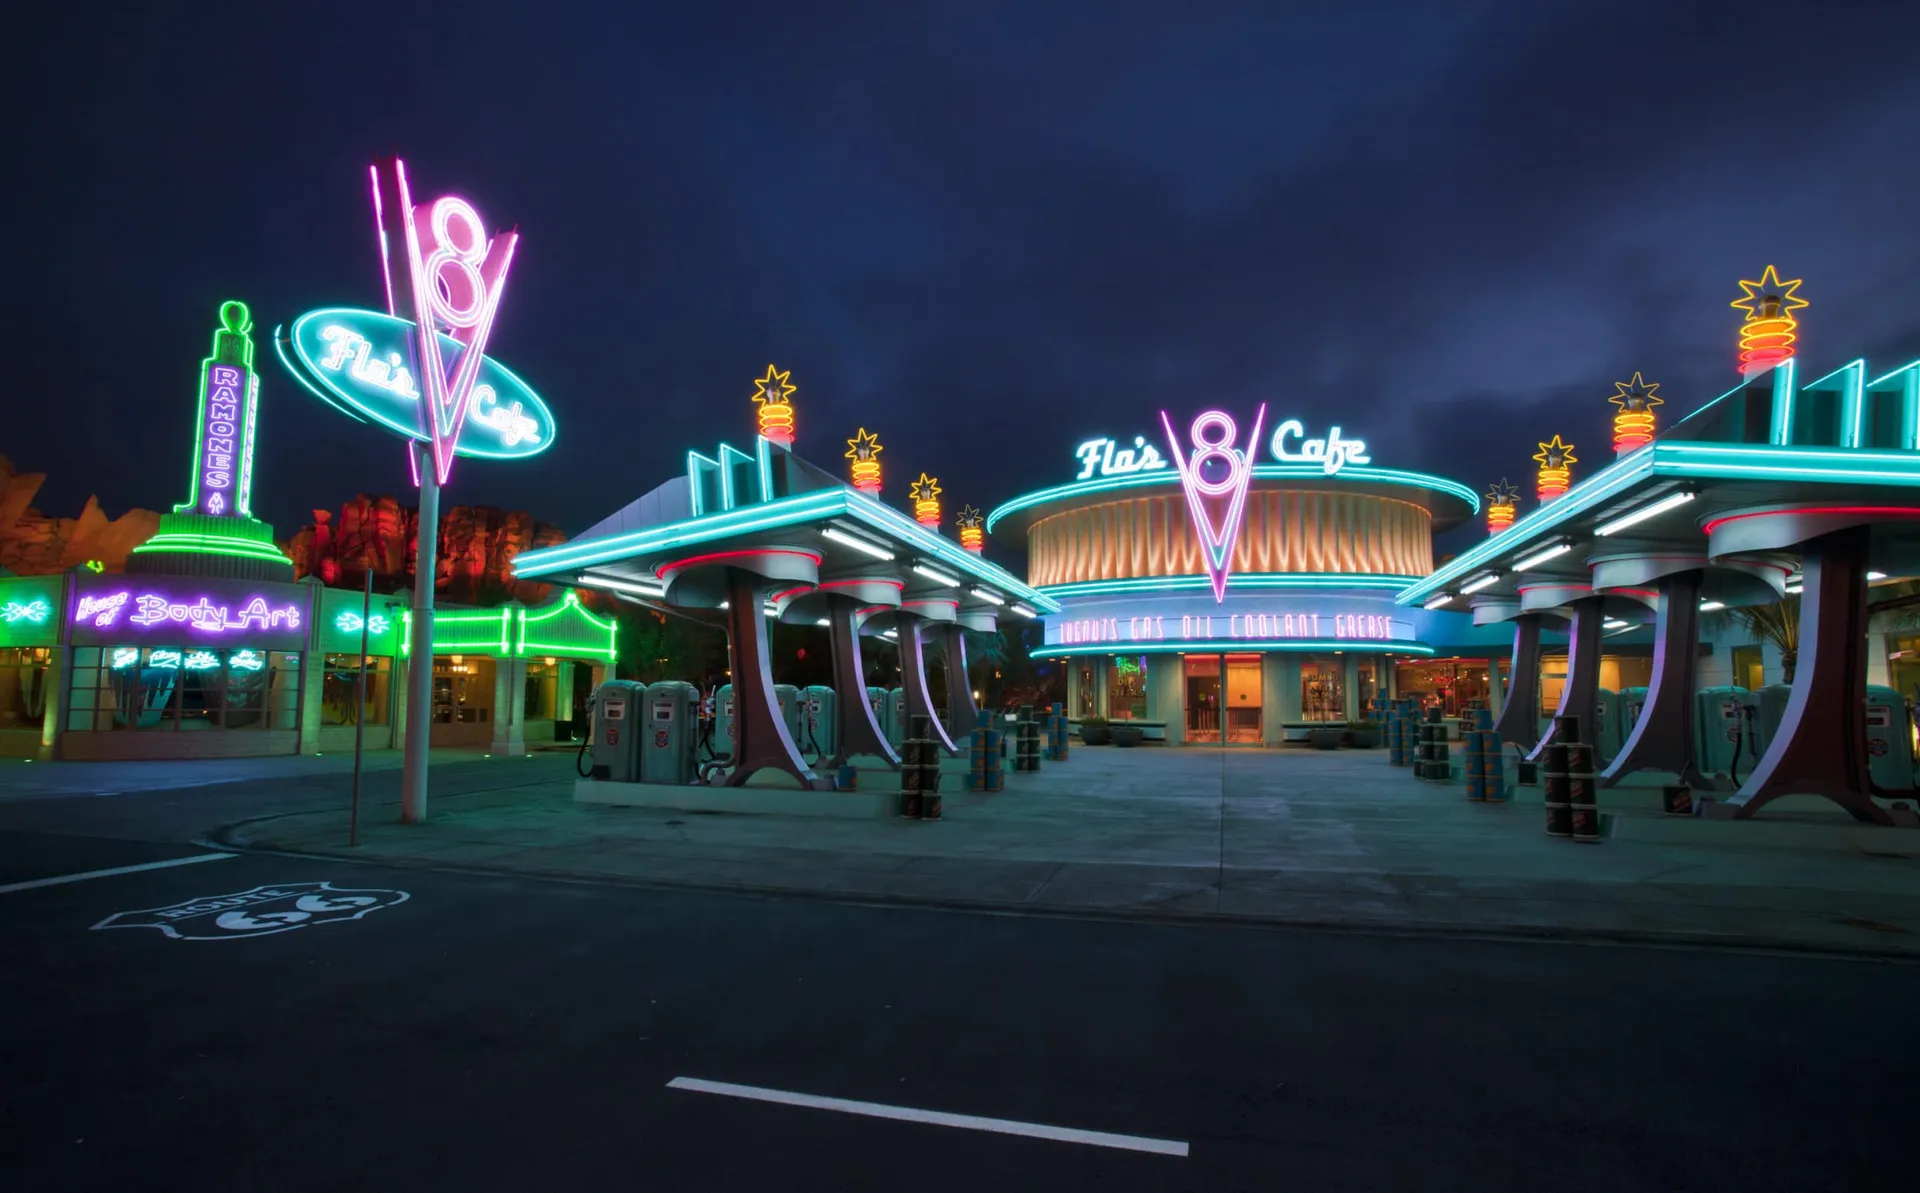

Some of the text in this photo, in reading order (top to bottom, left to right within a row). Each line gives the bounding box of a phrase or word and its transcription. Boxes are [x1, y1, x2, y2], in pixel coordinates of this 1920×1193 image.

[206, 367, 239, 488] RAMONES
[469, 384, 542, 446] Cafe
[1075, 436, 1168, 480] Flo's
[1271, 419, 1372, 475] Cafe
[75, 592, 129, 621] House
[96, 607, 119, 627] of
[130, 594, 300, 631] Body Art
[1060, 614, 1393, 644] LUGNUTS GAS OIL COOLANT GREASE
[155, 889, 295, 919] ROUTE
